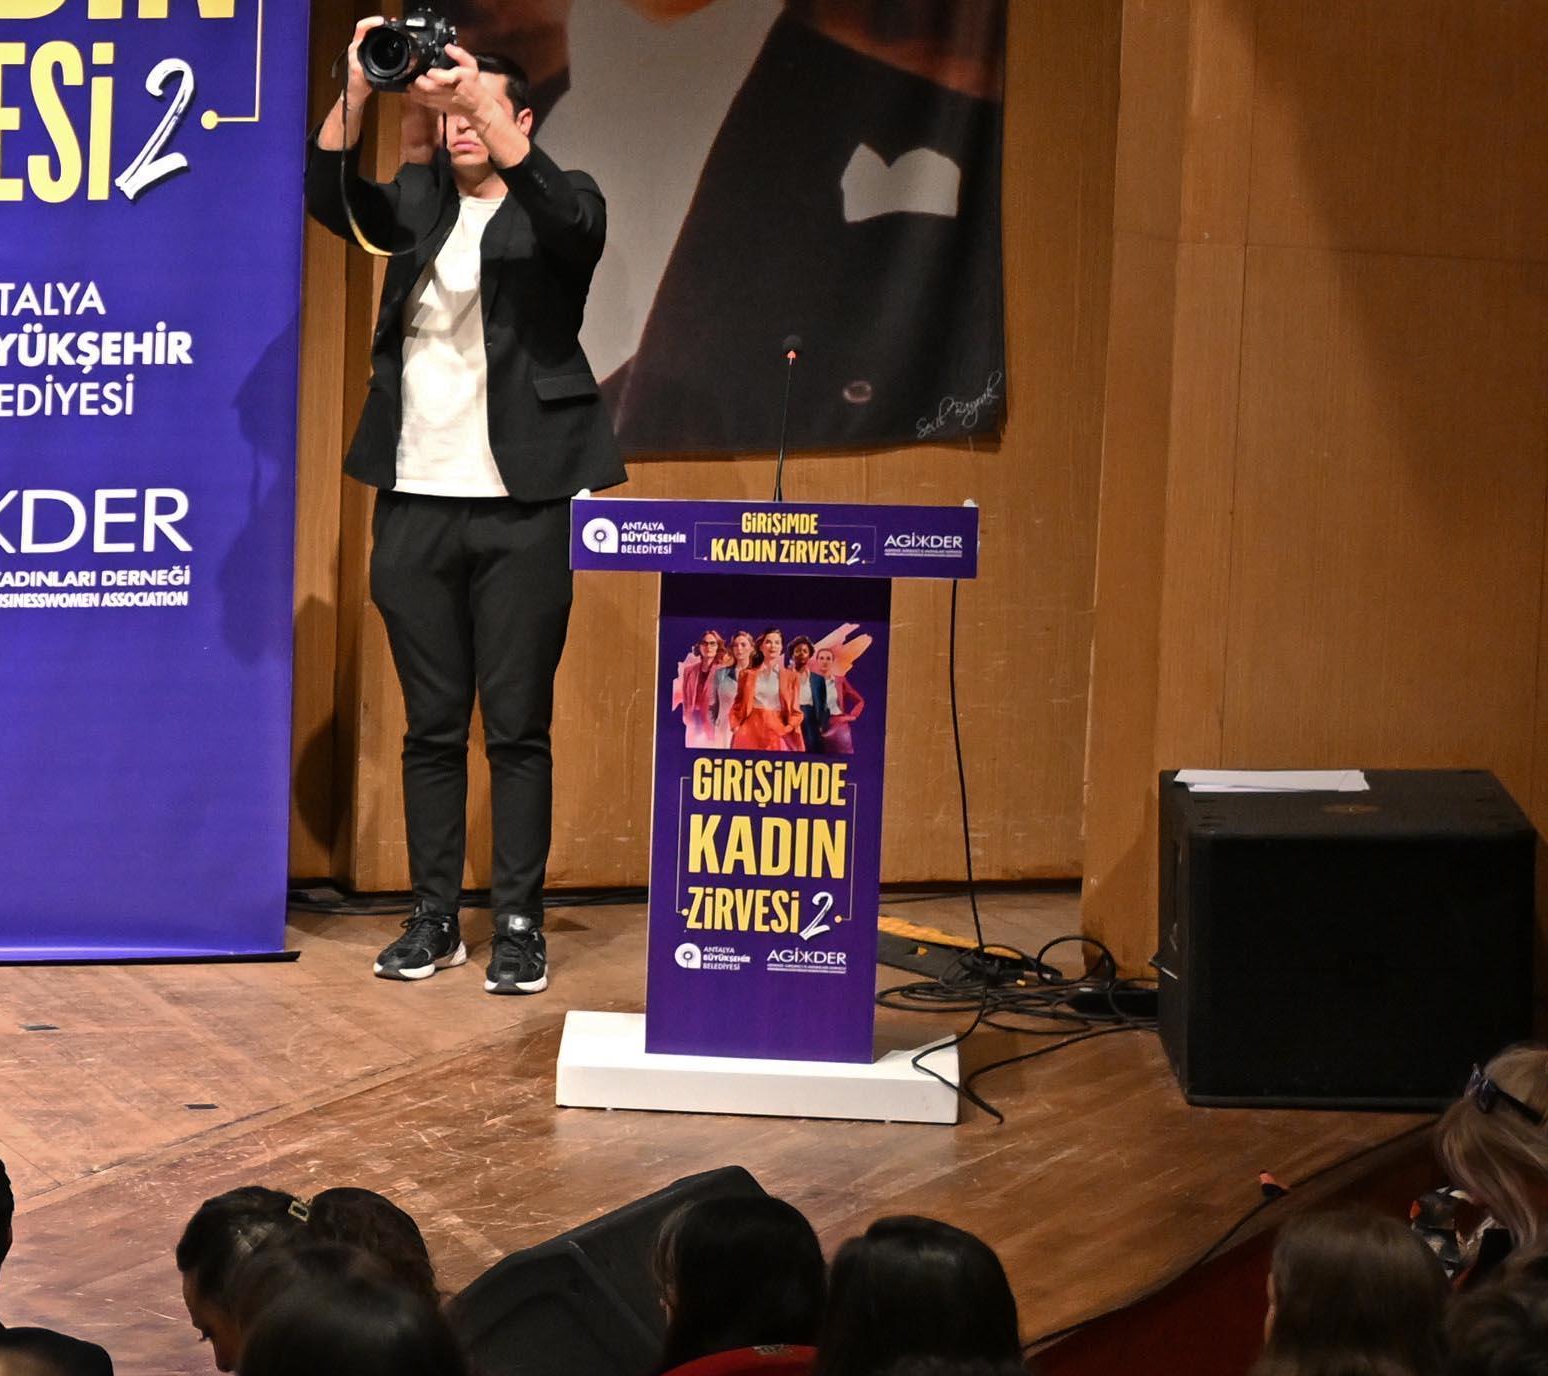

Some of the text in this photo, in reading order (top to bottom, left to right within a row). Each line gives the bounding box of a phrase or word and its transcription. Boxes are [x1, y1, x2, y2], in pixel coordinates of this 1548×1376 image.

[114, 58, 194, 200] 2
[621, 521, 665, 531] ANTALYA
[741, 512, 819, 536] GİRİŞİMDE
[621, 532, 687, 544] BÜYÜKŞEHİR
[620, 543, 672, 554] BELEDİYESİ
[710, 538, 777, 562] KADIN
[779, 540, 847, 564] ZİRVESİ
[846, 542, 862, 566] 2
[101, 566, 191, 586] DERNEĞİ
[101, 591, 188, 607] ASSOCIATION
[692, 757, 848, 808] GİRİŞİMDE
[688, 813, 847, 879] KADIN
[686, 886, 834, 941] ZİRVESİ 2
[702, 946, 735, 954] ANTALYA
[702, 962, 741, 971] BELEDİYESİ
